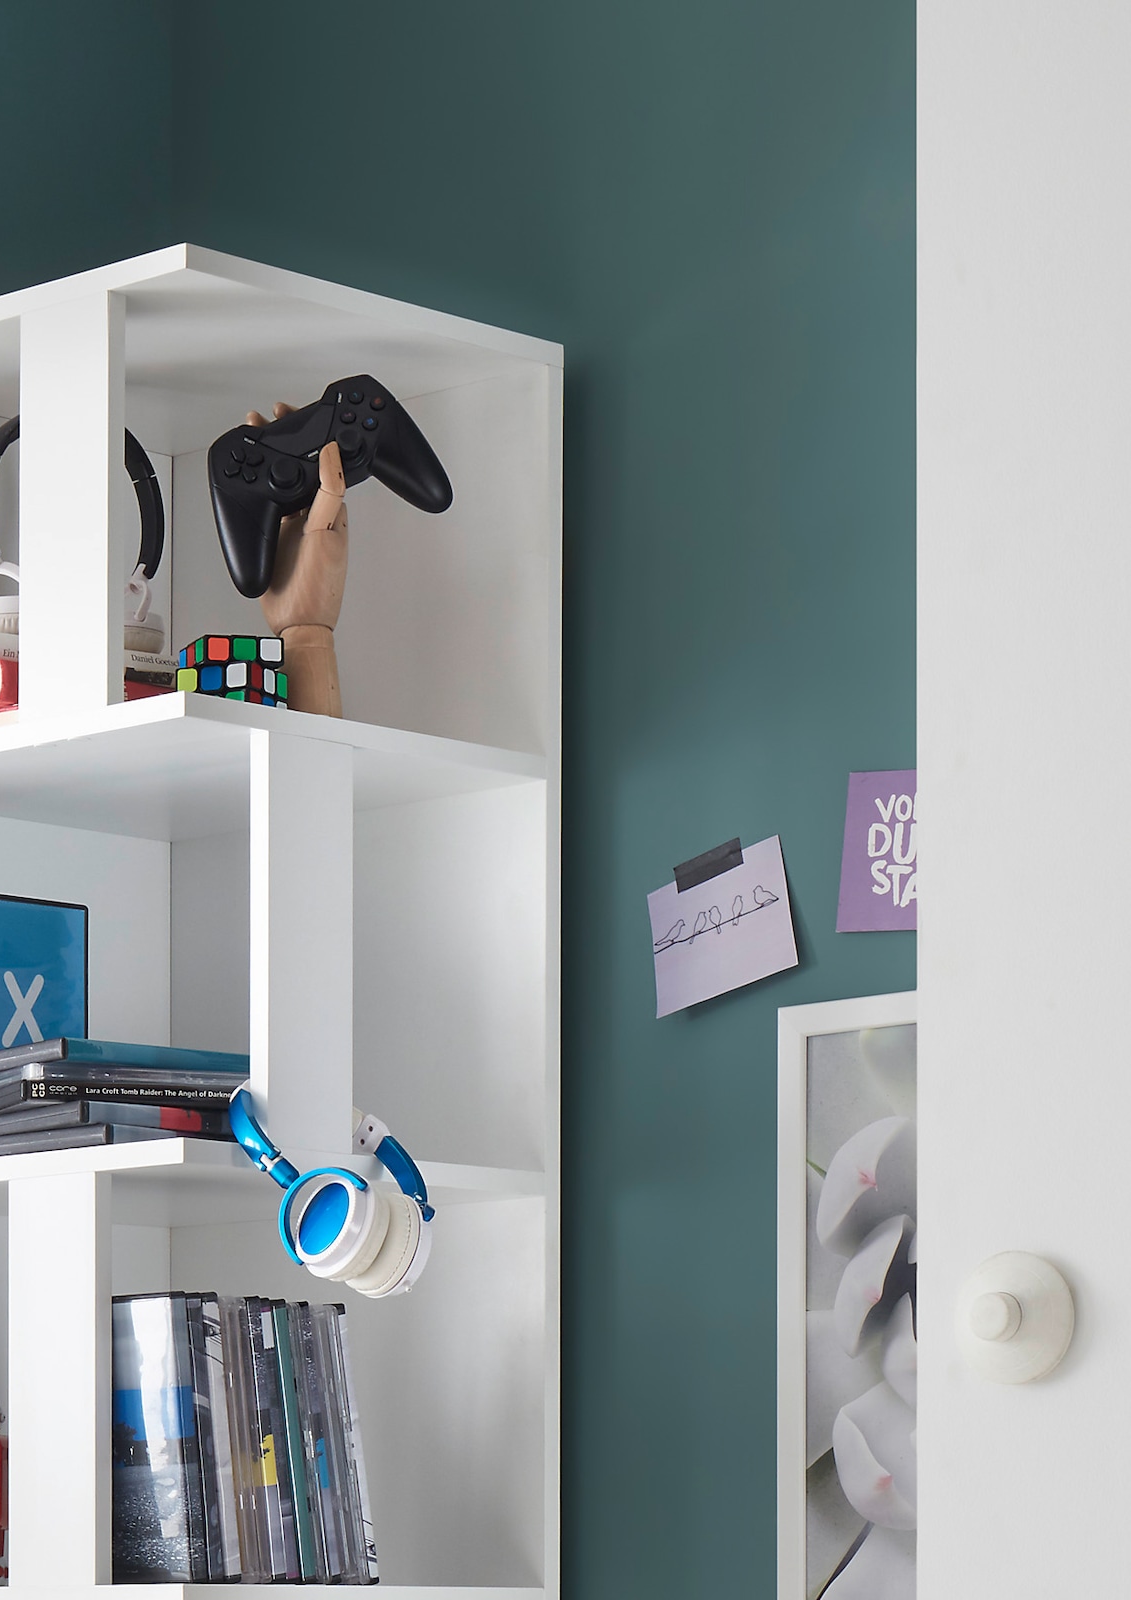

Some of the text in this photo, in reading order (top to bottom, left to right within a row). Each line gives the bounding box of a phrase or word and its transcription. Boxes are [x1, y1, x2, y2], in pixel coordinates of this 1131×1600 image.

[2, 648, 15, 658] Ein
[131, 654, 155, 664] Daniel
[874, 793, 916, 823] VO
[1, 970, 45, 1048] X
[31, 1083, 39, 1098] PC
[39, 1083, 46, 1098] CD
[85, 1087, 100, 1095] Lara
[102, 1087, 119, 1096] Croft
[120, 1088, 138, 1096] Tomb
[139, 1089, 164, 1097] Raider:
[164, 1089, 176, 1097] The
[178, 1090, 198, 1098] Angel
[199, 1090, 207, 1098] of
